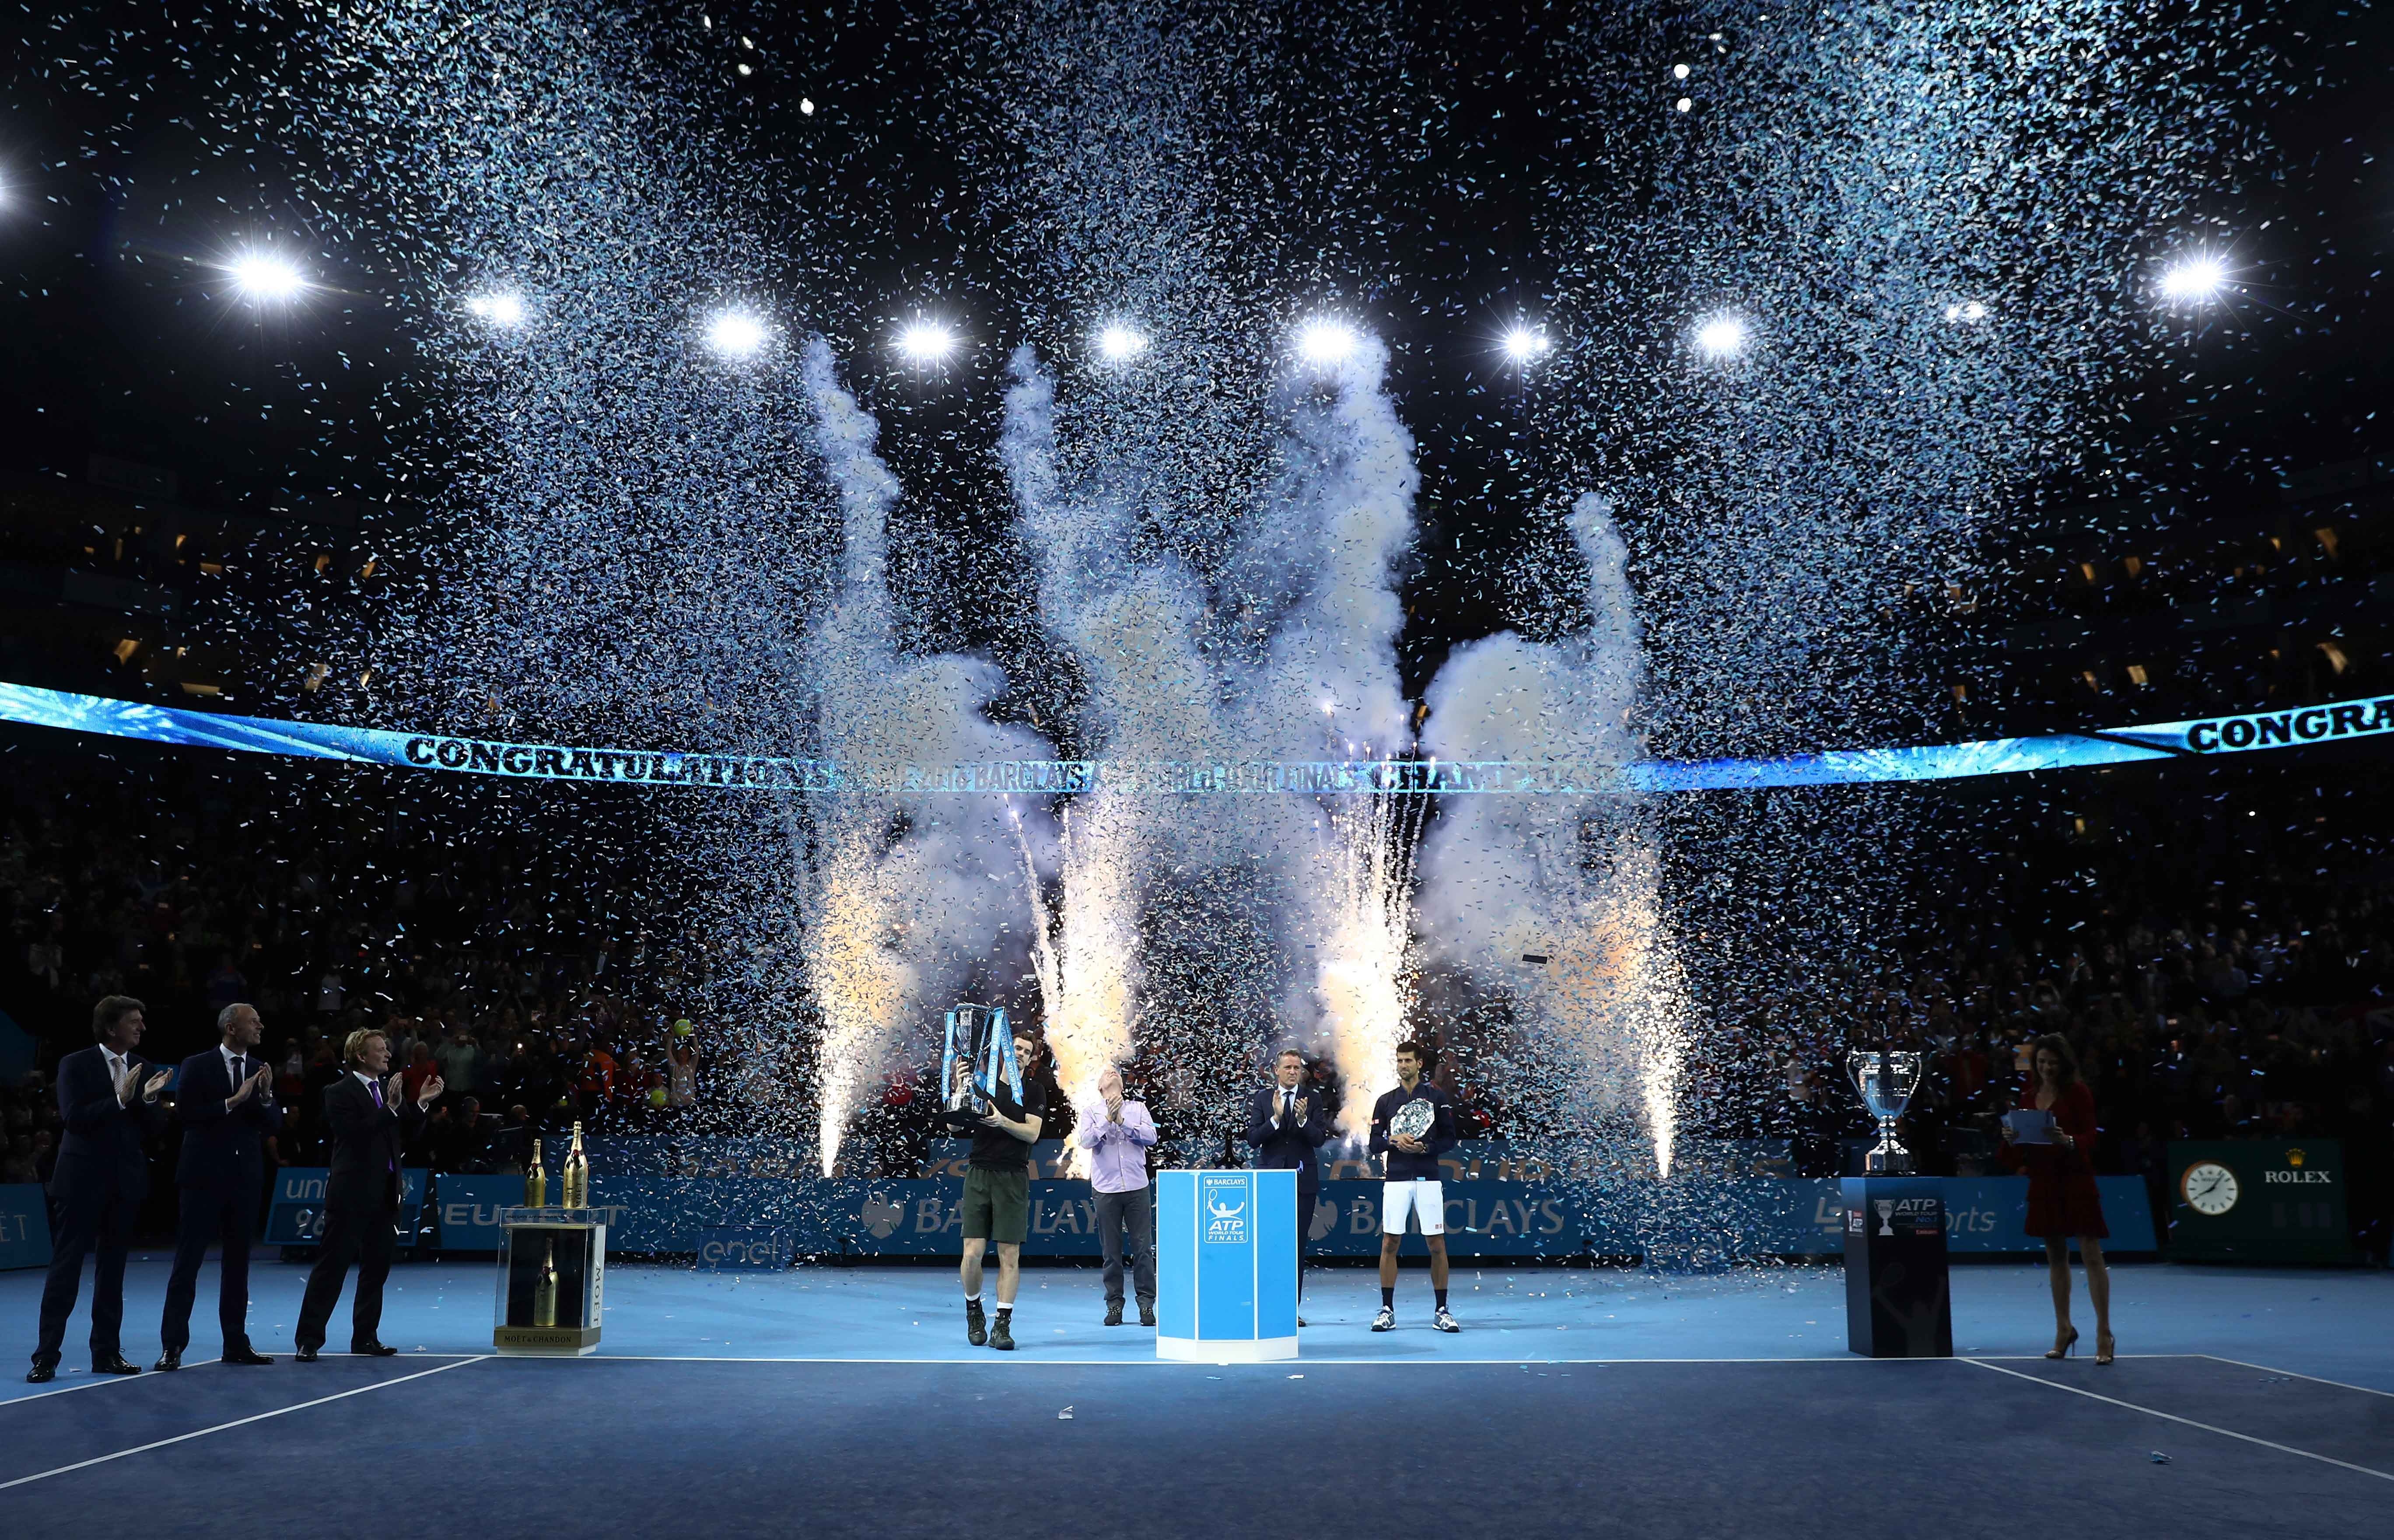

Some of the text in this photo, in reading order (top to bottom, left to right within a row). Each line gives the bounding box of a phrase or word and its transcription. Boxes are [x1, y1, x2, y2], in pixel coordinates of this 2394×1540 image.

[975, 763, 1089, 791] BARCLAYS
[1008, 1061, 1018, 1090] BARCLAYS
[2264, 1171, 2331, 1183] ROLEX
[438, 1203, 629, 1226] EUGEOT
[914, 1199, 1100, 1235] BALAY
[1349, 1199, 1565, 1235] BCLAYS
[1895, 1199, 1937, 1211] ATP
[1209, 1220, 1244, 1231] ATP
[703, 1236, 780, 1268] enel
